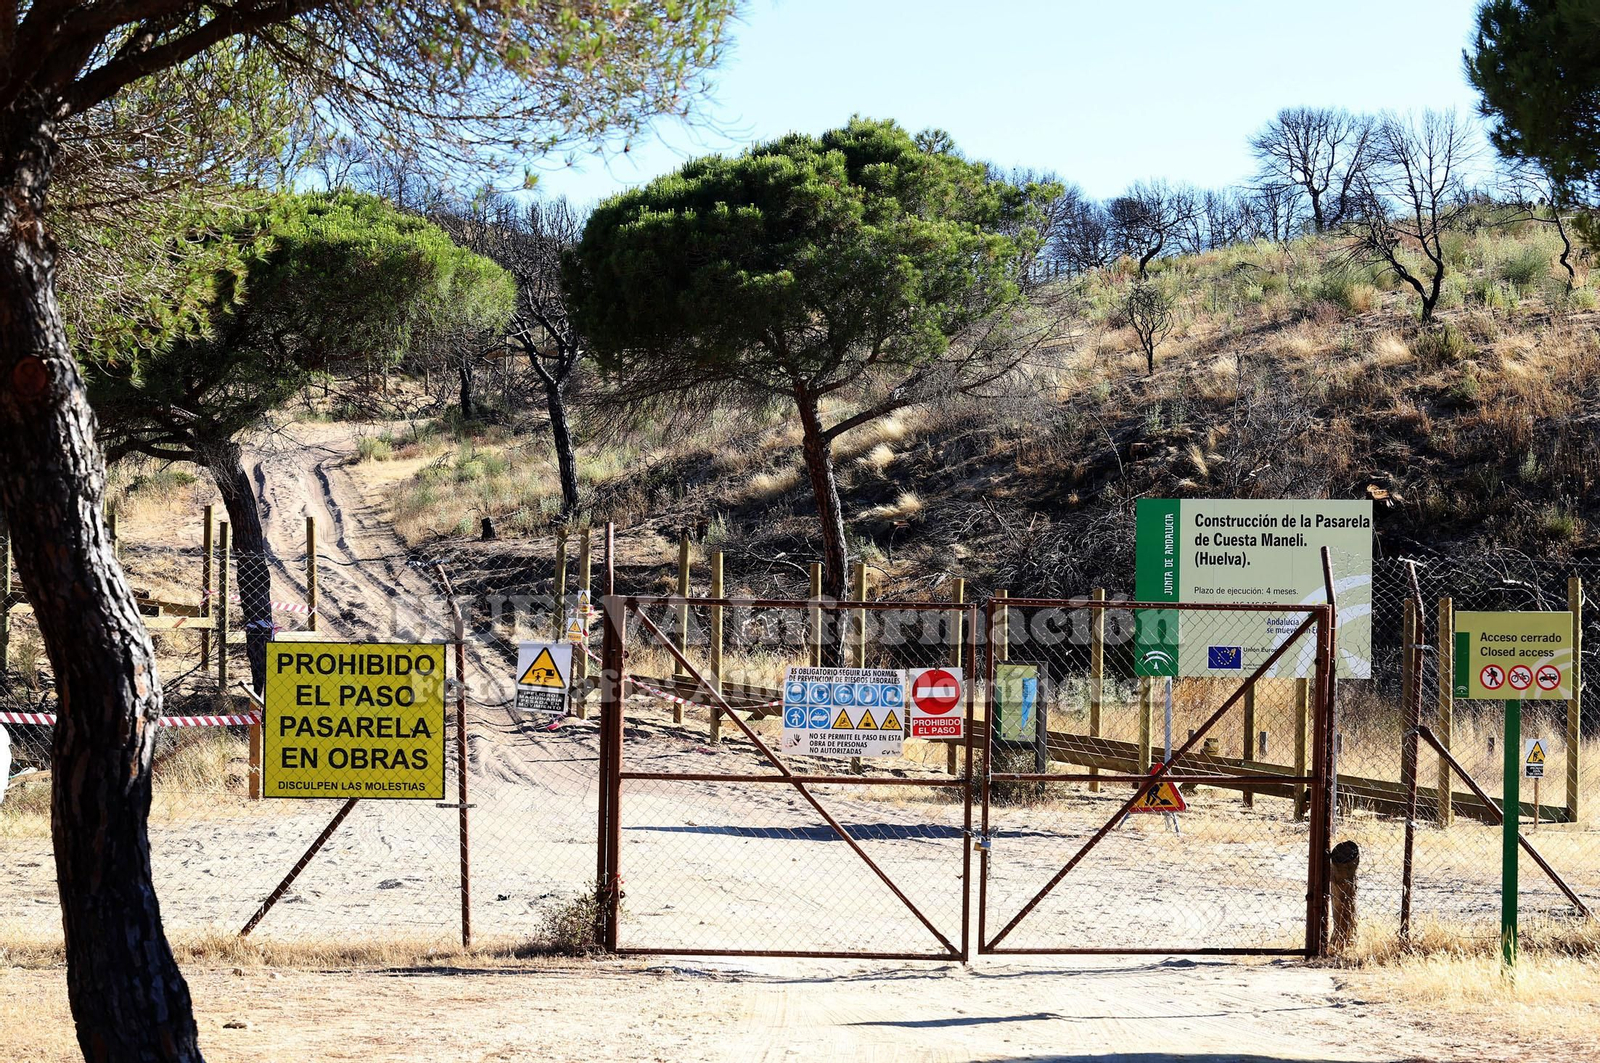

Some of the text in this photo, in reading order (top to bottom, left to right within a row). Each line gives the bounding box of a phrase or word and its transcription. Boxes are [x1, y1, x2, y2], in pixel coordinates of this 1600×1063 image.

[1194, 513, 1371, 528] Construcción de la Pasarela
[1194, 533, 1308, 547] de Cuesta Maneli.
[1164, 558, 1174, 568] DE
[1194, 551, 1251, 568] (Huelva).
[1164, 571, 1174, 596] JUNTA
[1194, 586, 1299, 596] Plazo de ejecución: 4 meses.
[1480, 632, 1562, 643] Acceso cerrado
[1480, 646, 1555, 658] Closed access
[276, 652, 435, 676] PROHIBIDO
[798, 668, 838, 676] OBLIGATORIO
[839, 668, 861, 676] SEGUIR
[862, 669, 872, 677] LAS
[873, 669, 898, 677] NORMAS
[296, 684, 416, 708] EL PASO
[279, 715, 432, 739] PASARELA
[913, 718, 961, 727] PROHIBIDO
[918, 726, 956, 735] EL PASO
[820, 747, 862, 755] AUTORIZADAS
[281, 747, 429, 770] EN OBRAS
[278, 780, 426, 791] DISCULPEN LAS MOLESTIAS
